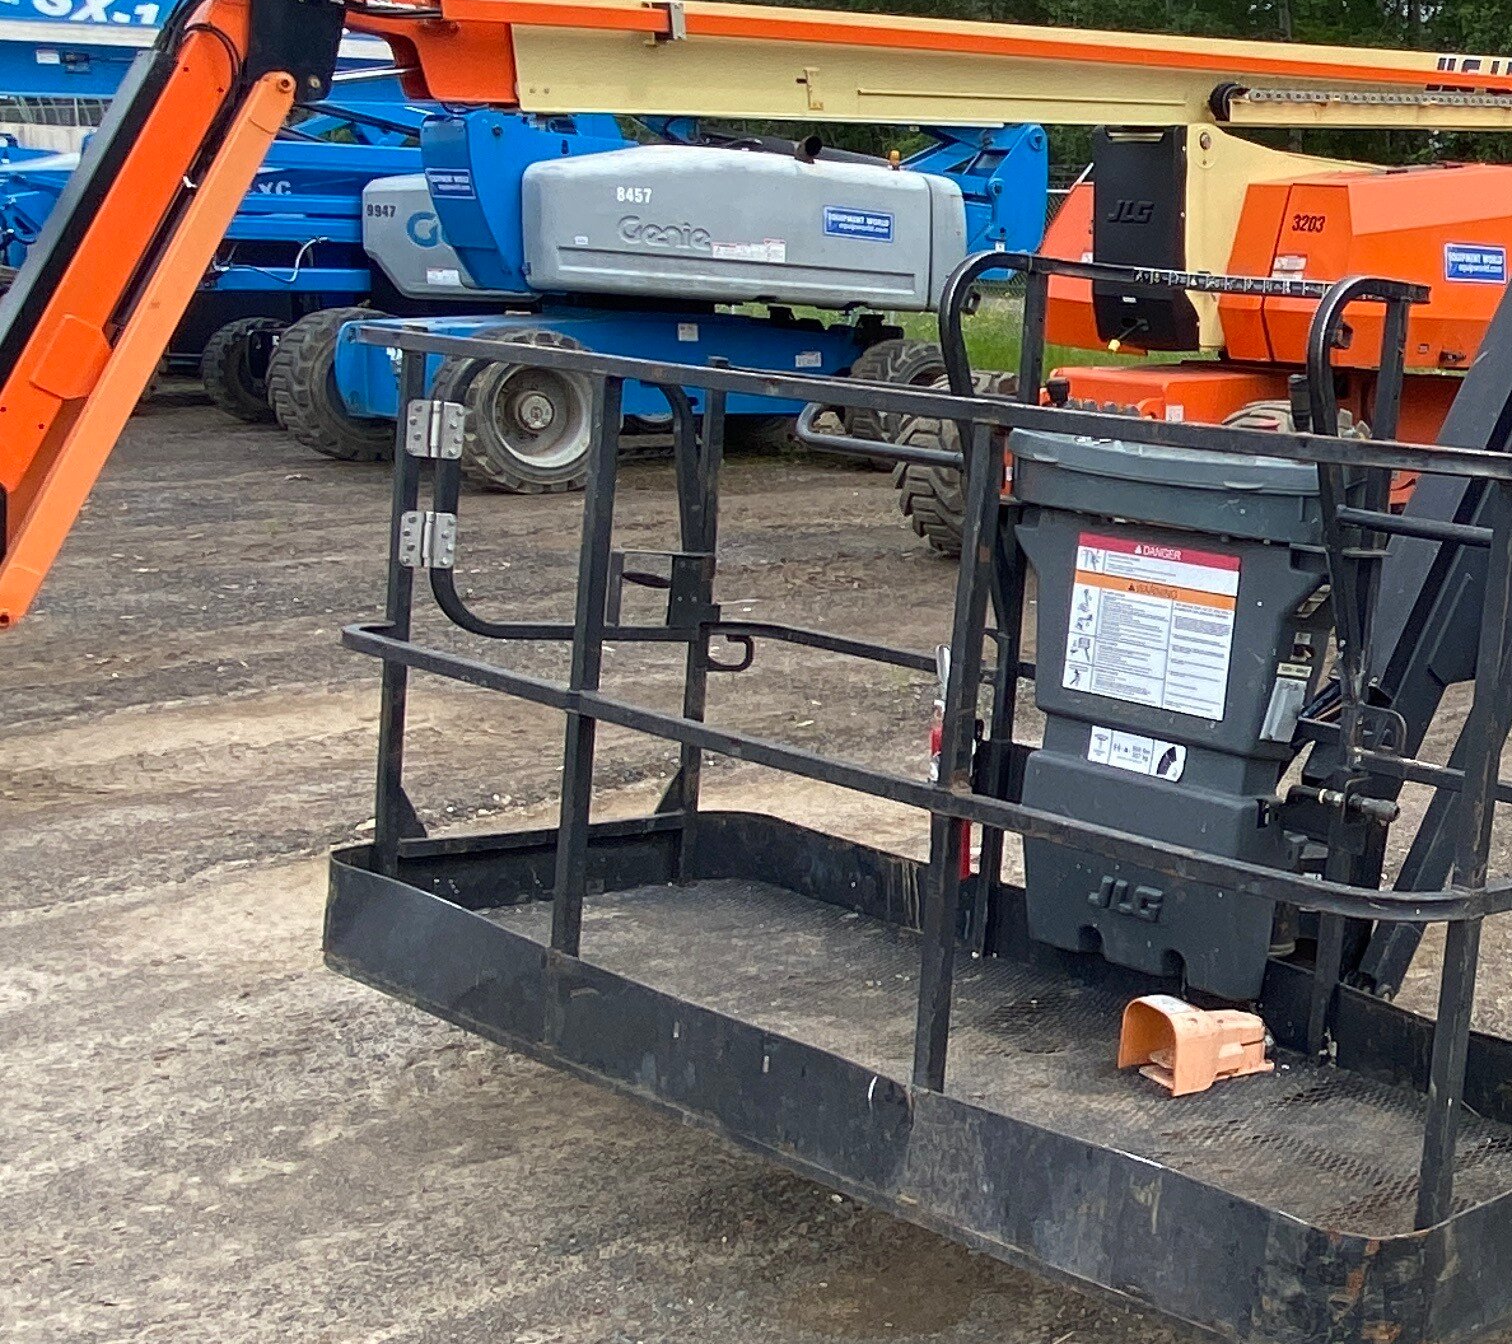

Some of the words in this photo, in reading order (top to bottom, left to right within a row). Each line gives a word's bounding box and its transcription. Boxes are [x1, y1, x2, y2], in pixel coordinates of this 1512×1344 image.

[616, 186, 652, 204] 8457
[366, 204, 396, 218] 9947
[1107, 199, 1154, 224] JLG
[617, 214, 712, 251] Genie
[1292, 213, 1326, 233] 3203
[1143, 545, 1181, 561] DANGER
[1088, 875, 1163, 923] JLG
